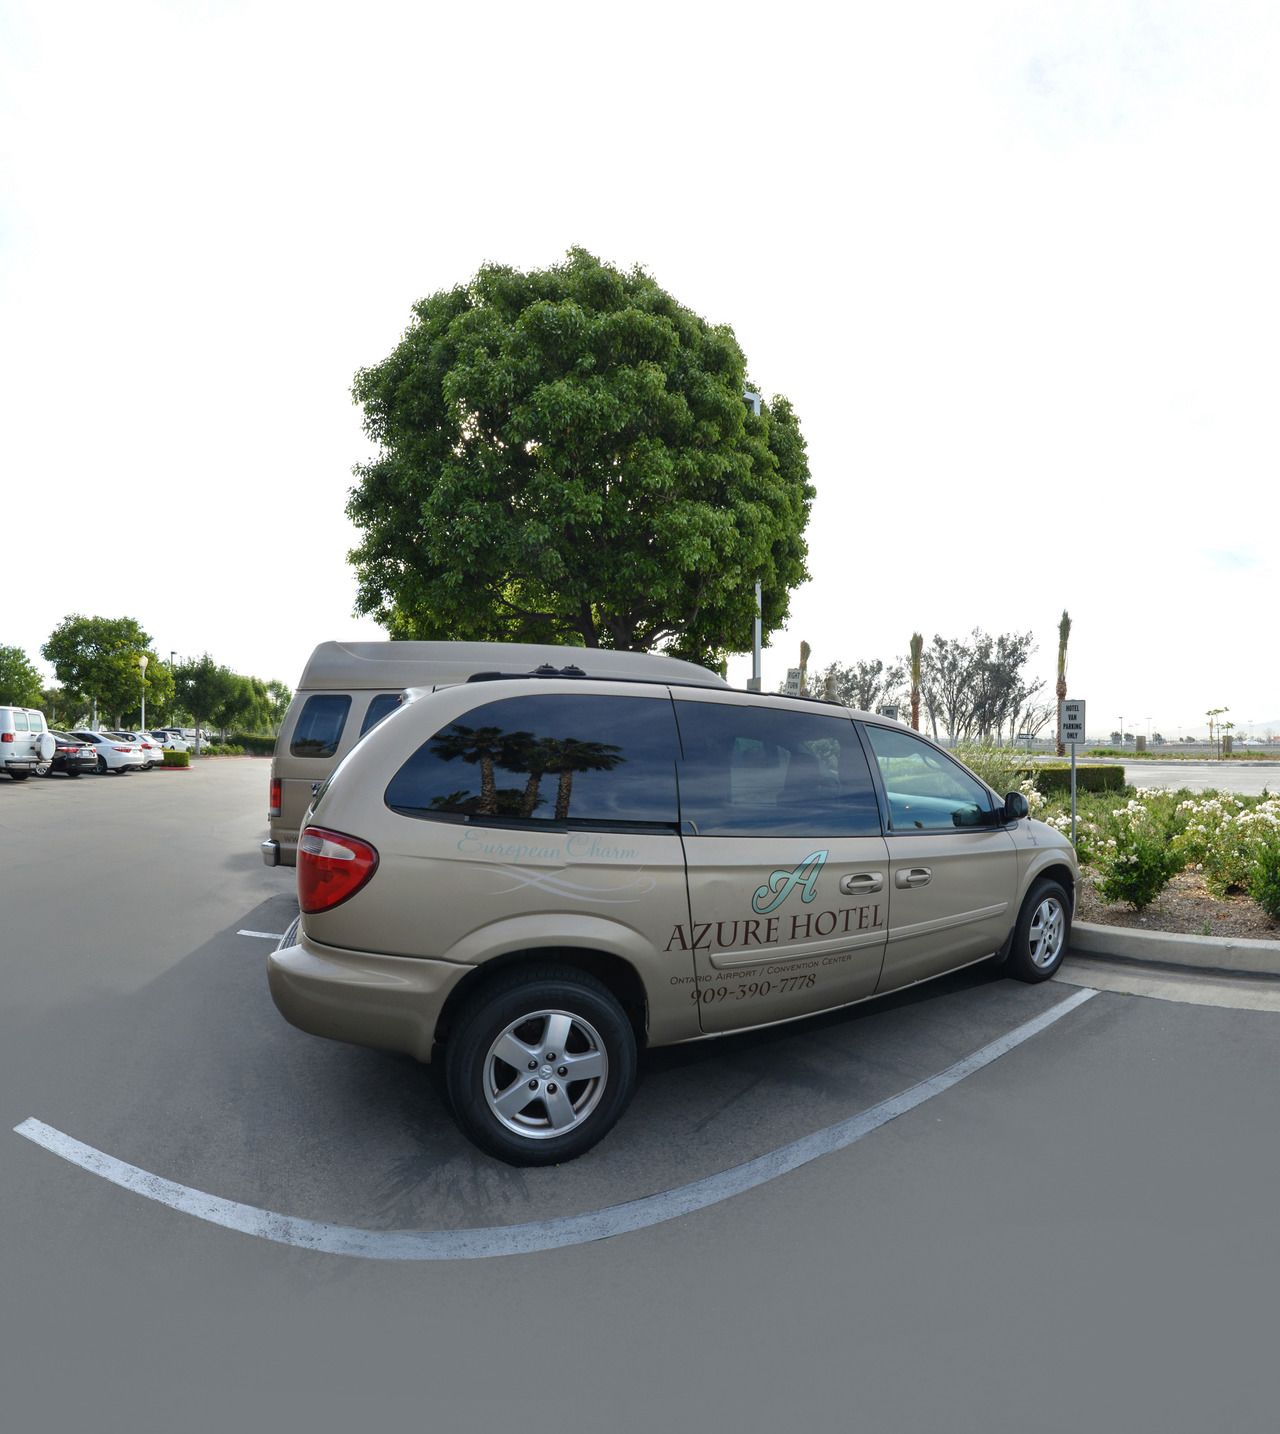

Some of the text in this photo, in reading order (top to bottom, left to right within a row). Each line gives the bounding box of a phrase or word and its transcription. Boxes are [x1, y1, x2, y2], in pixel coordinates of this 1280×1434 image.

[1062, 722, 1082, 730] PARKING
[1067, 713, 1078, 721] VAN
[1066, 731, 1078, 739] ONLY
[457, 829, 641, 864] European Charm
[751, 850, 829, 914] A
[662, 904, 883, 952] AZURE HOTEL
[670, 975, 712, 985] ONTARIO
[716, 969, 757, 981] AIRPORT
[767, 961, 819, 975] CONVENTION
[822, 954, 852, 966] CENTER
[688, 973, 816, 1007] 909-390-7778
